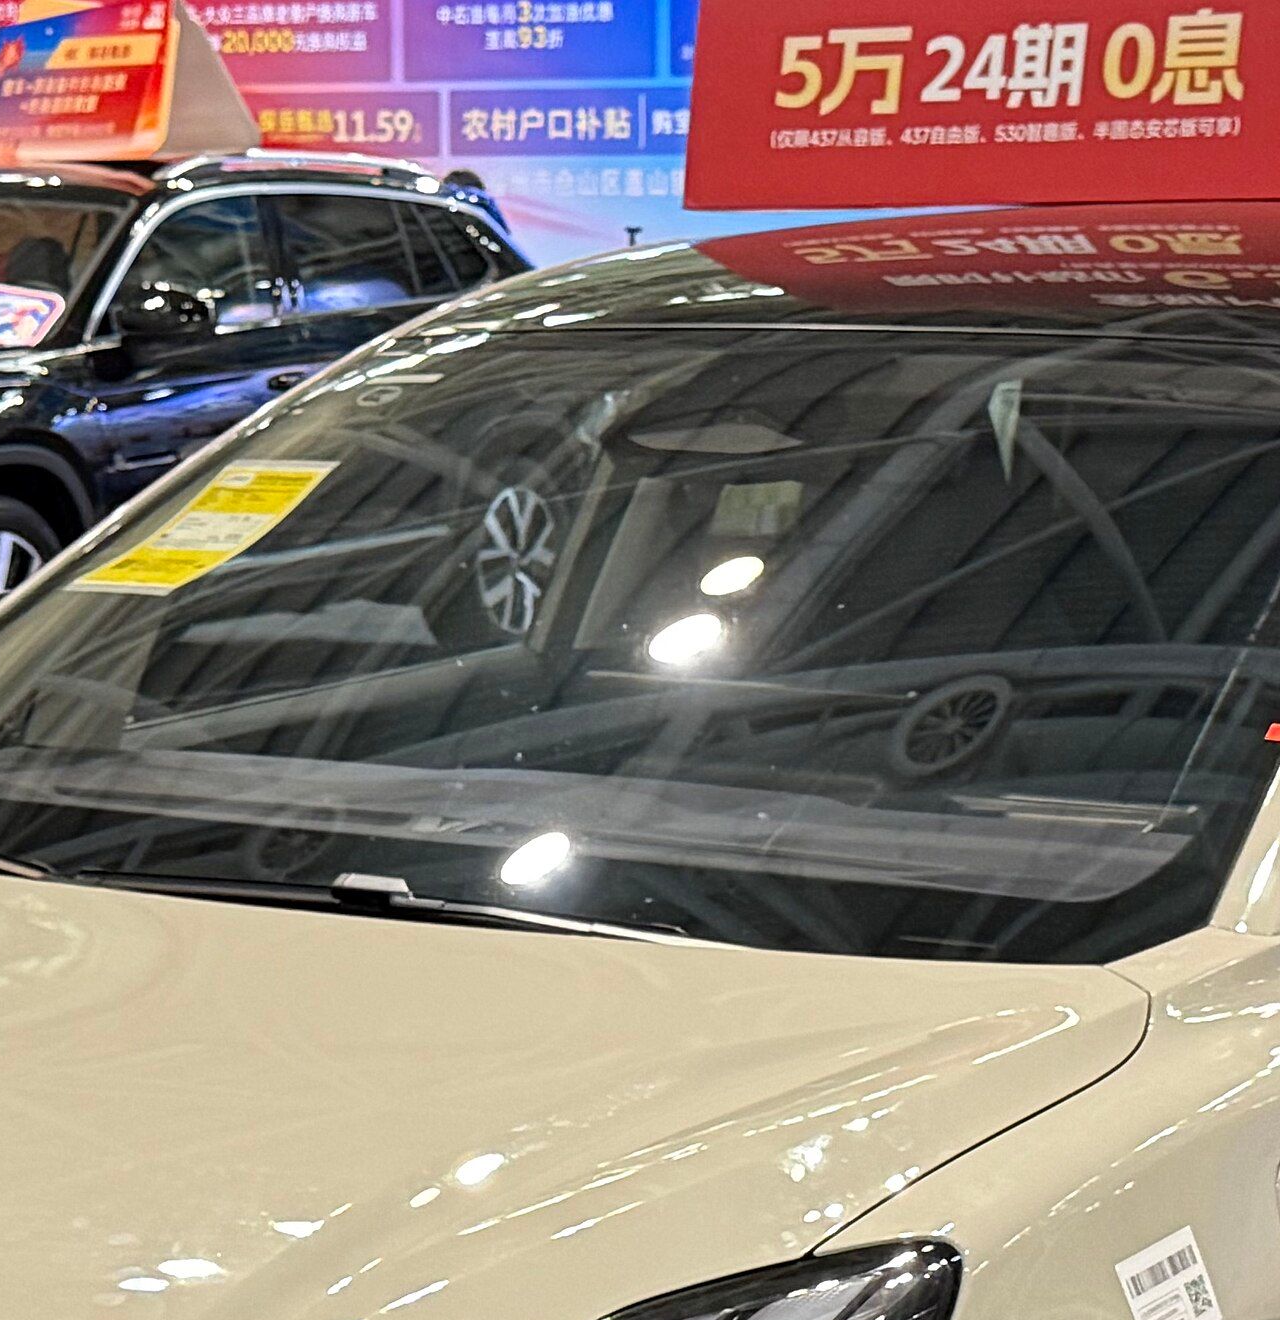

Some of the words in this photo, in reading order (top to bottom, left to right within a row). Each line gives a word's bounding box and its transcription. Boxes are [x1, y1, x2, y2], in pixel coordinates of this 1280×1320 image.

[774, 26, 913, 117] 5万
[921, 22, 1089, 109] 24期
[1102, 7, 1245, 106] 0息
[333, 108, 414, 143] 11.59
[461, 107, 632, 142] 农村户口补贴
